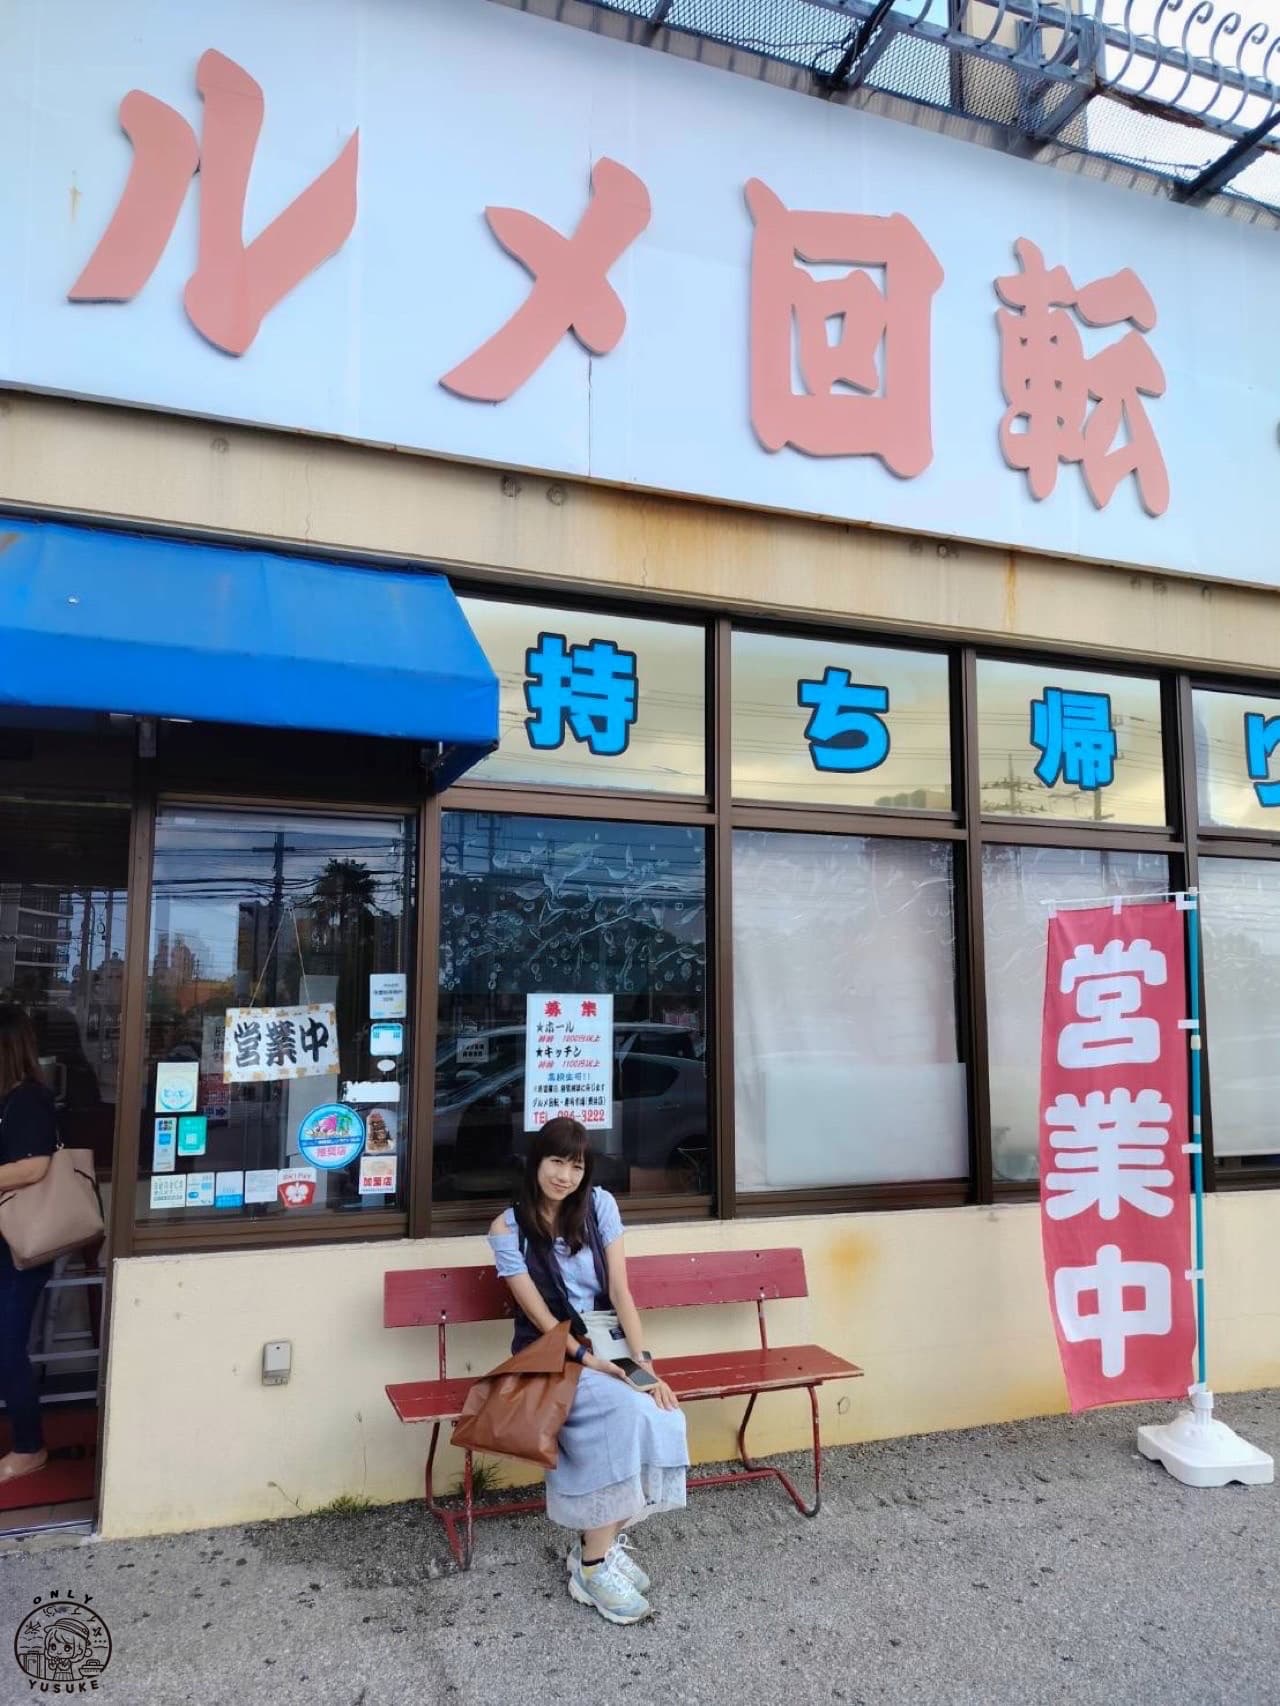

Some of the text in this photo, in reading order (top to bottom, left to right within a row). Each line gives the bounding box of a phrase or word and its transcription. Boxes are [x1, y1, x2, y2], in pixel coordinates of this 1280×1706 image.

[67, 47, 1170, 518] ルメ回転
[233, 1017, 329, 1068] 営業中
[1045, 939, 1173, 1378] 営業中
